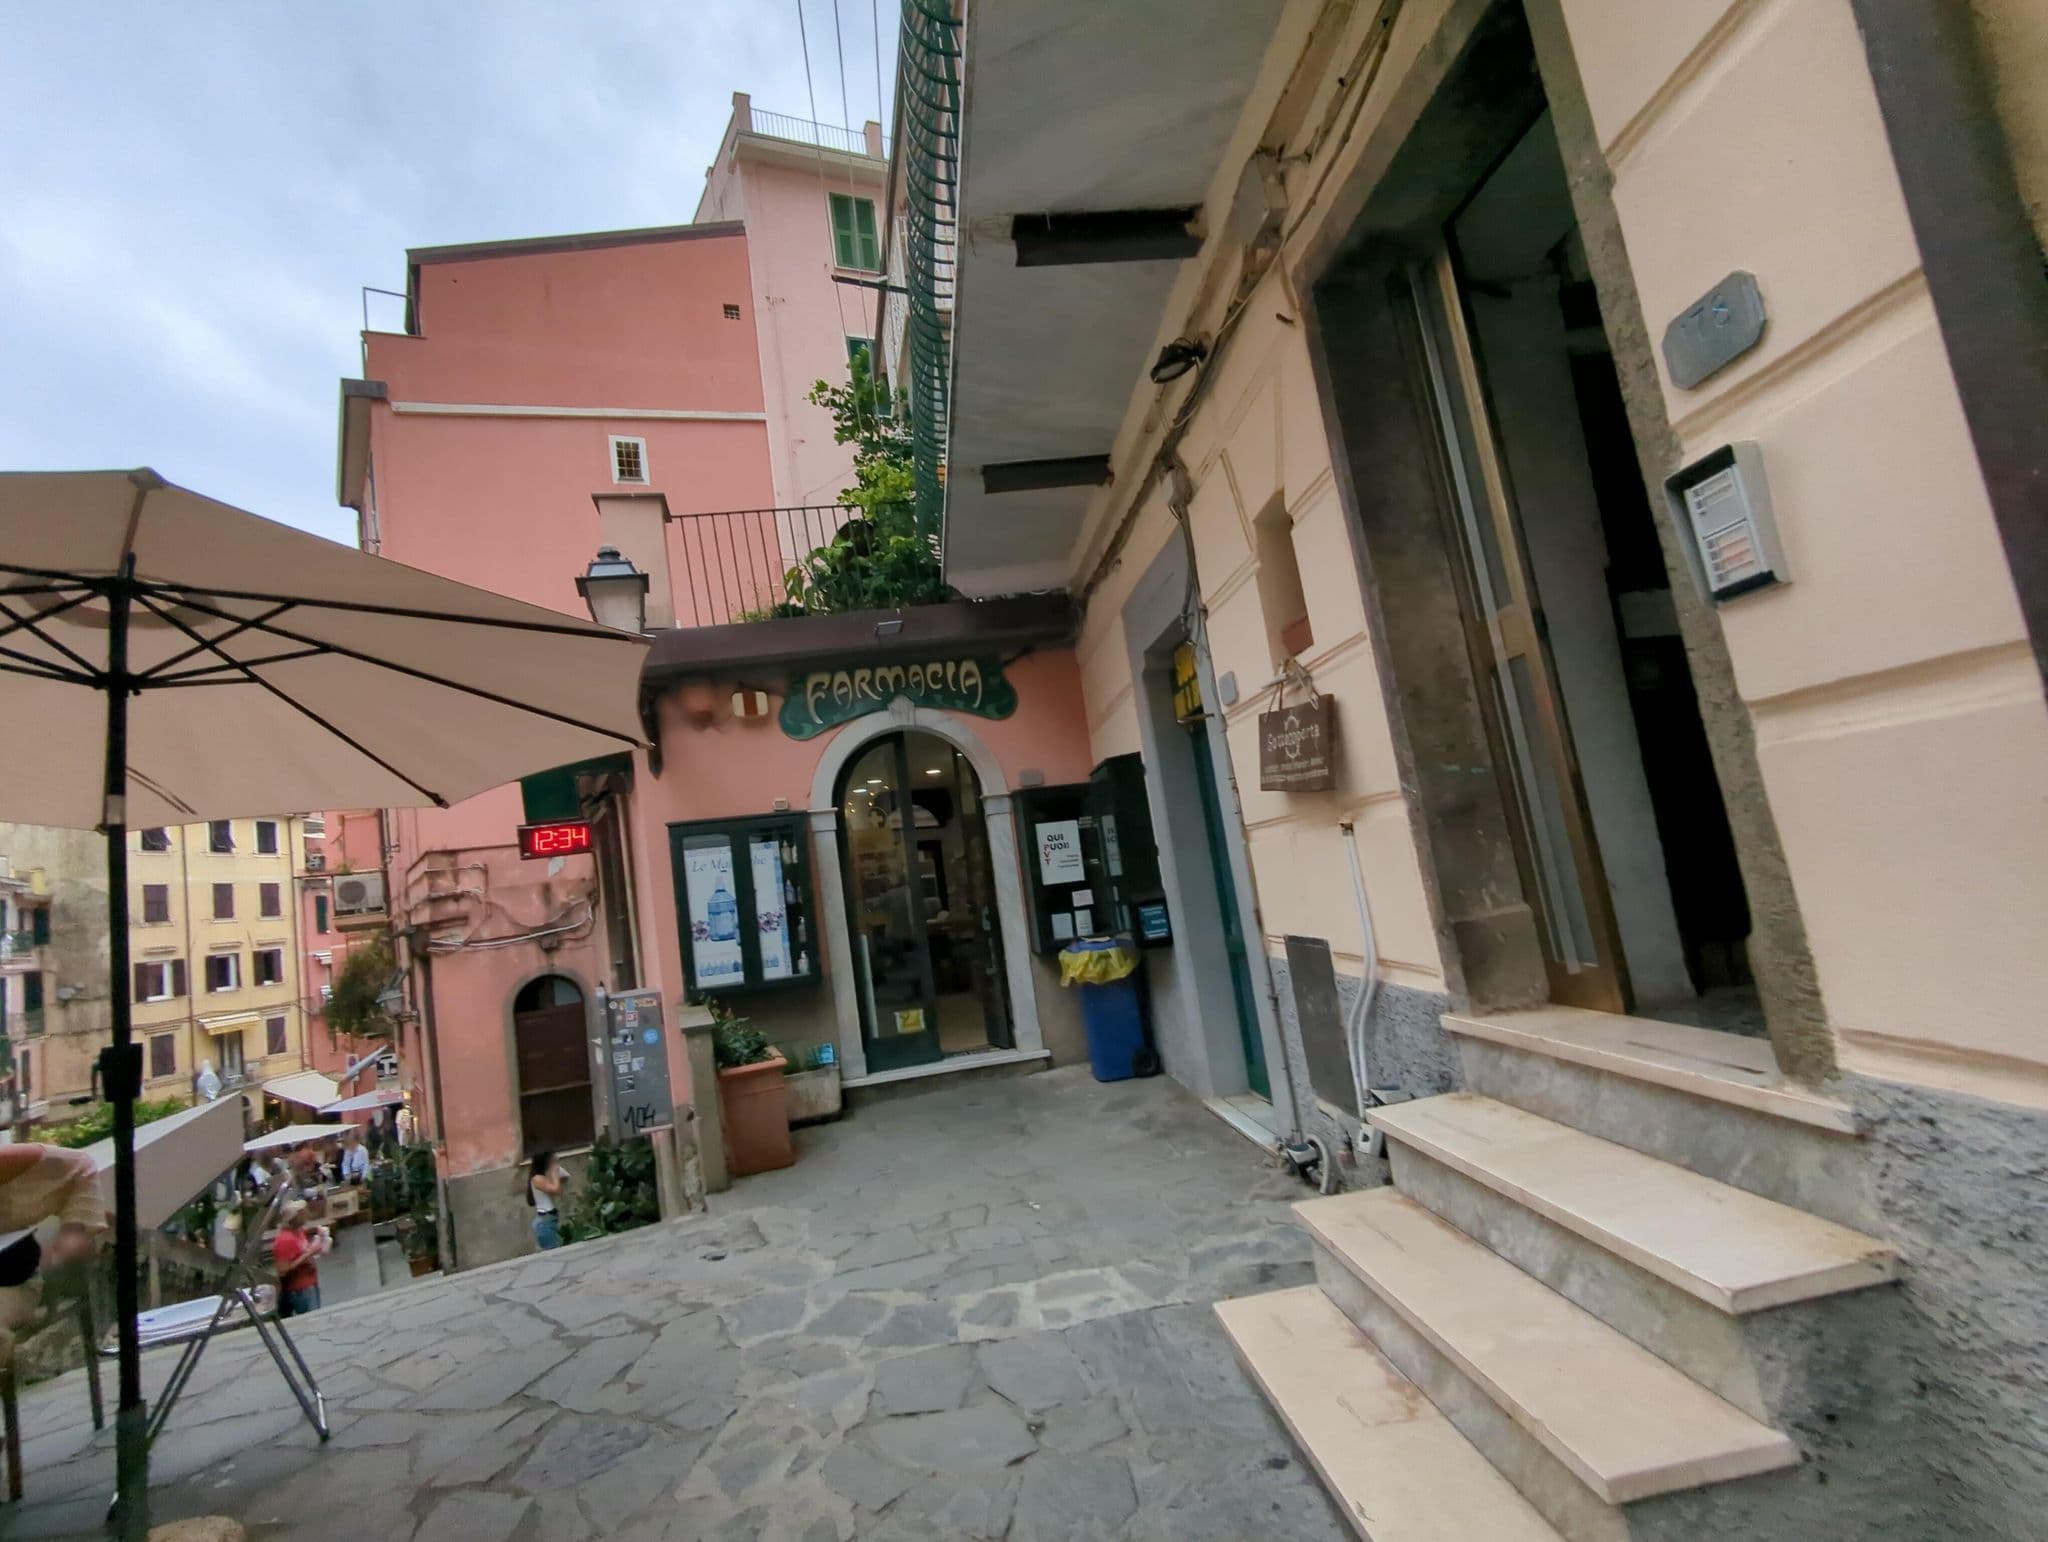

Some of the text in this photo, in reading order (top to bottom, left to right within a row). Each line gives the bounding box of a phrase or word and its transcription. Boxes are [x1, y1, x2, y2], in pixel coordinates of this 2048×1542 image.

[807, 659, 982, 724] FARMACIA
[534, 827, 587, 851] 12:34
[1047, 833, 1064, 843] QUI
